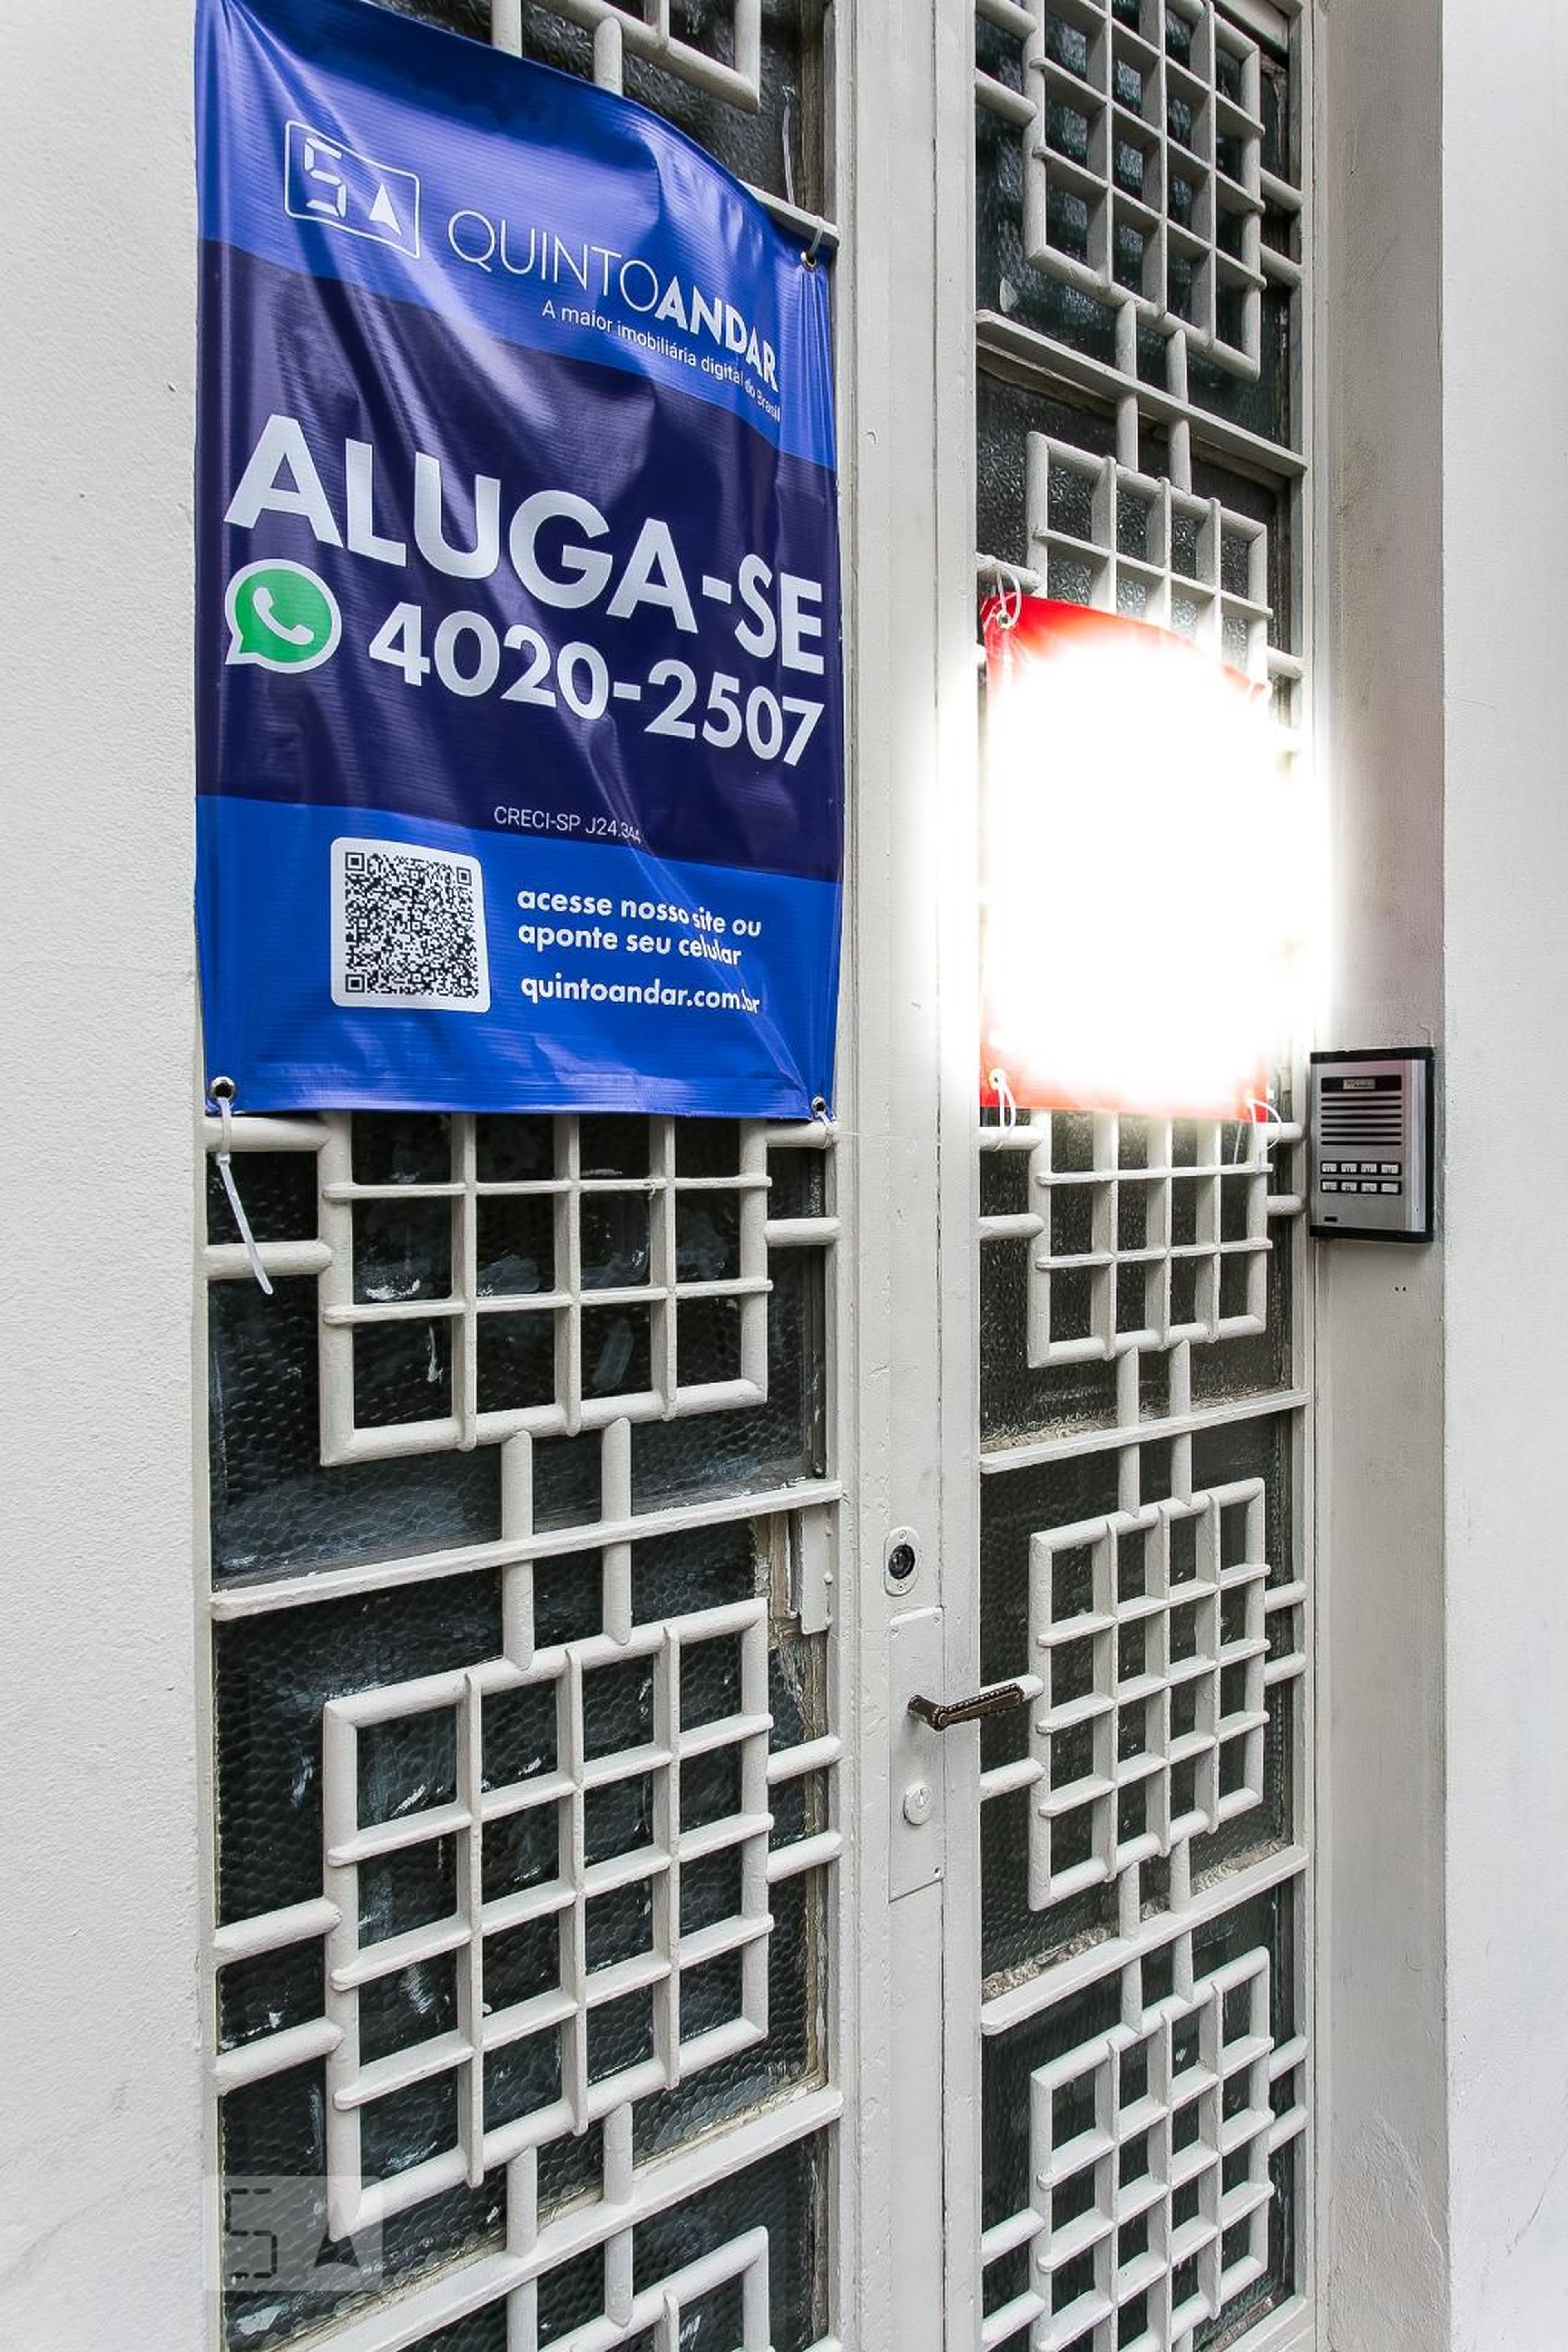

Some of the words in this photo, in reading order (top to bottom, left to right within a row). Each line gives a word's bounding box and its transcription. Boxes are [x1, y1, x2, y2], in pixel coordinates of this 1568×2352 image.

[448, 209, 779, 393] QUINTOANDAR
[541, 299, 556, 319] A
[561, 307, 613, 333] maior
[617, 320, 697, 367] imobiliária
[701, 355, 744, 386] digital
[744, 378, 756, 398] do
[756, 390, 781, 423] Brasil
[223, 413, 825, 675] ALUGA-SE
[368, 601, 825, 766] 4020-2507
[494, 806, 581, 832] CRECI-SP
[517, 890, 613, 916] acesse
[621, 899, 690, 925] nosso
[691, 906, 726, 933] site
[731, 919, 762, 937] ou
[518, 924, 618, 952] aponte
[626, 934, 671, 955] seu
[678, 934, 742, 966] celular
[521, 972, 761, 1014] quintoandar.com.br
